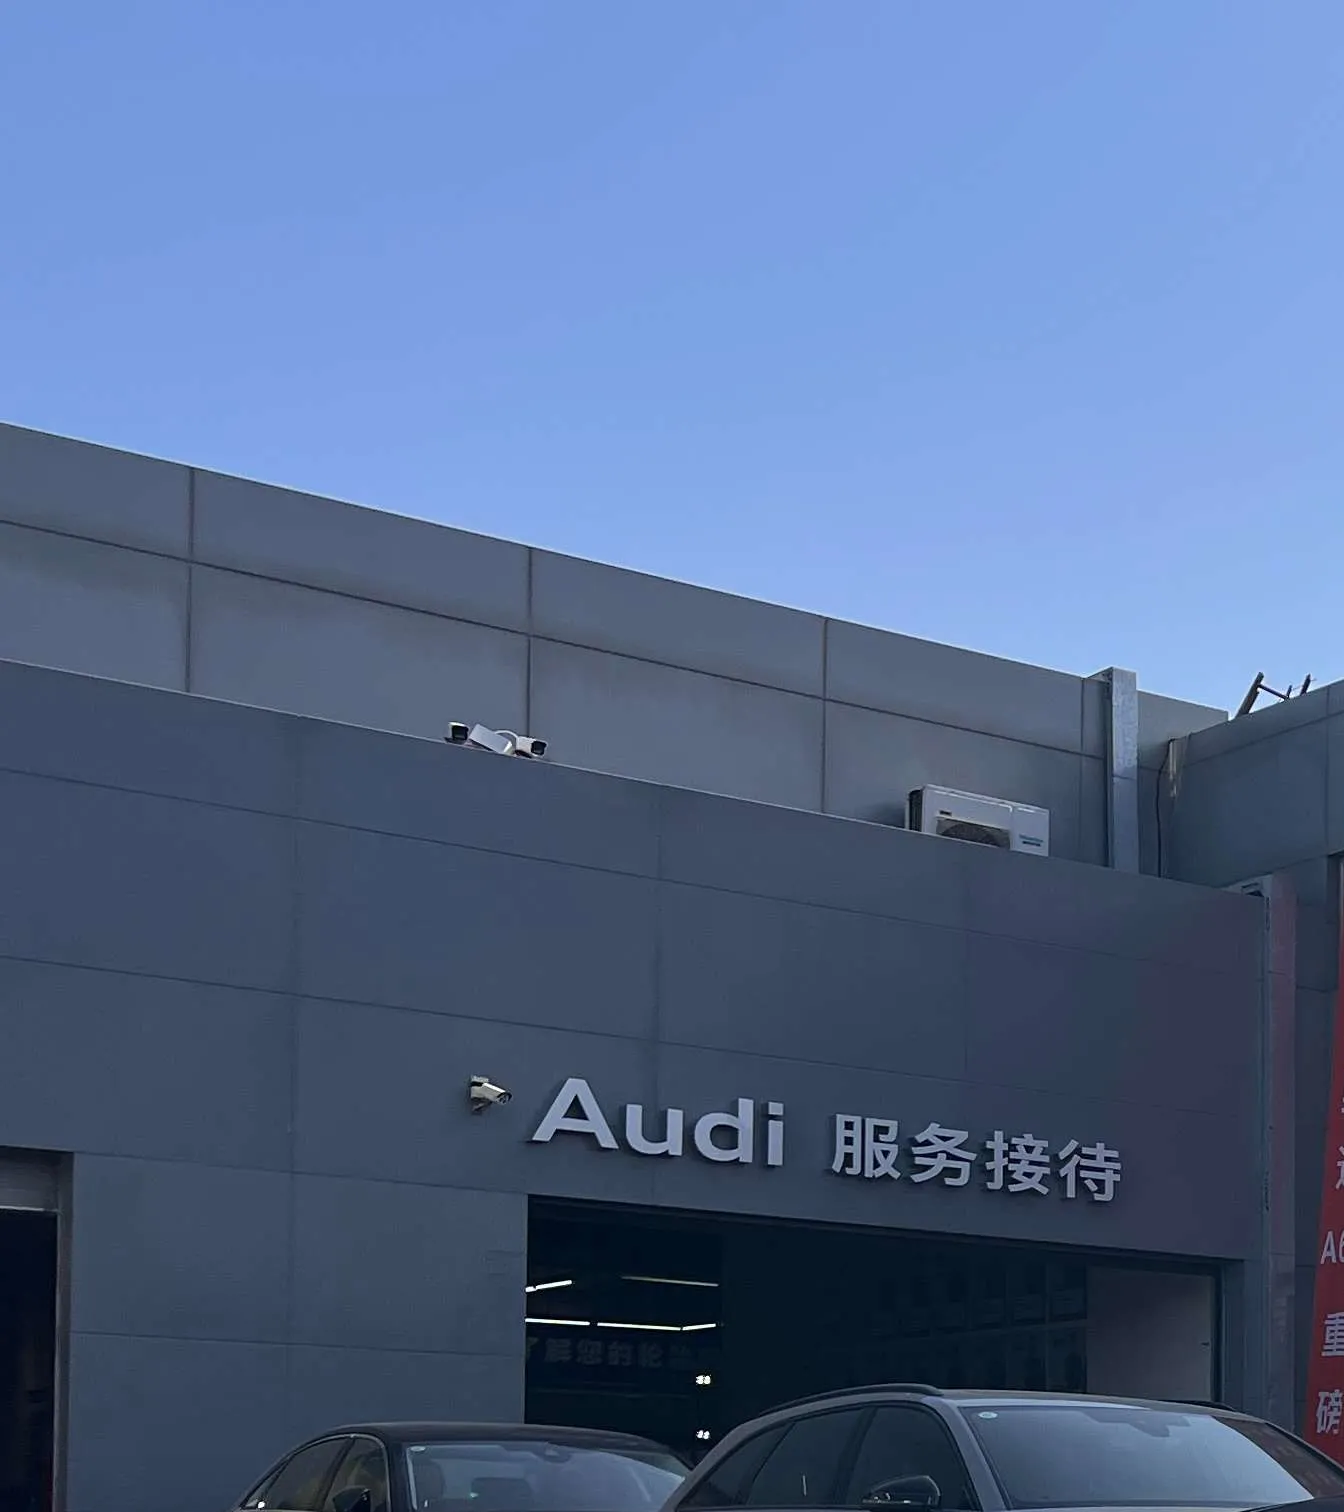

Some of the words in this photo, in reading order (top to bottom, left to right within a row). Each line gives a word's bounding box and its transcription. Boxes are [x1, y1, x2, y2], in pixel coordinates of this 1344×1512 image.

[530, 1077, 785, 1167] Audi
[831, 1113, 1123, 1202] 服务接待
